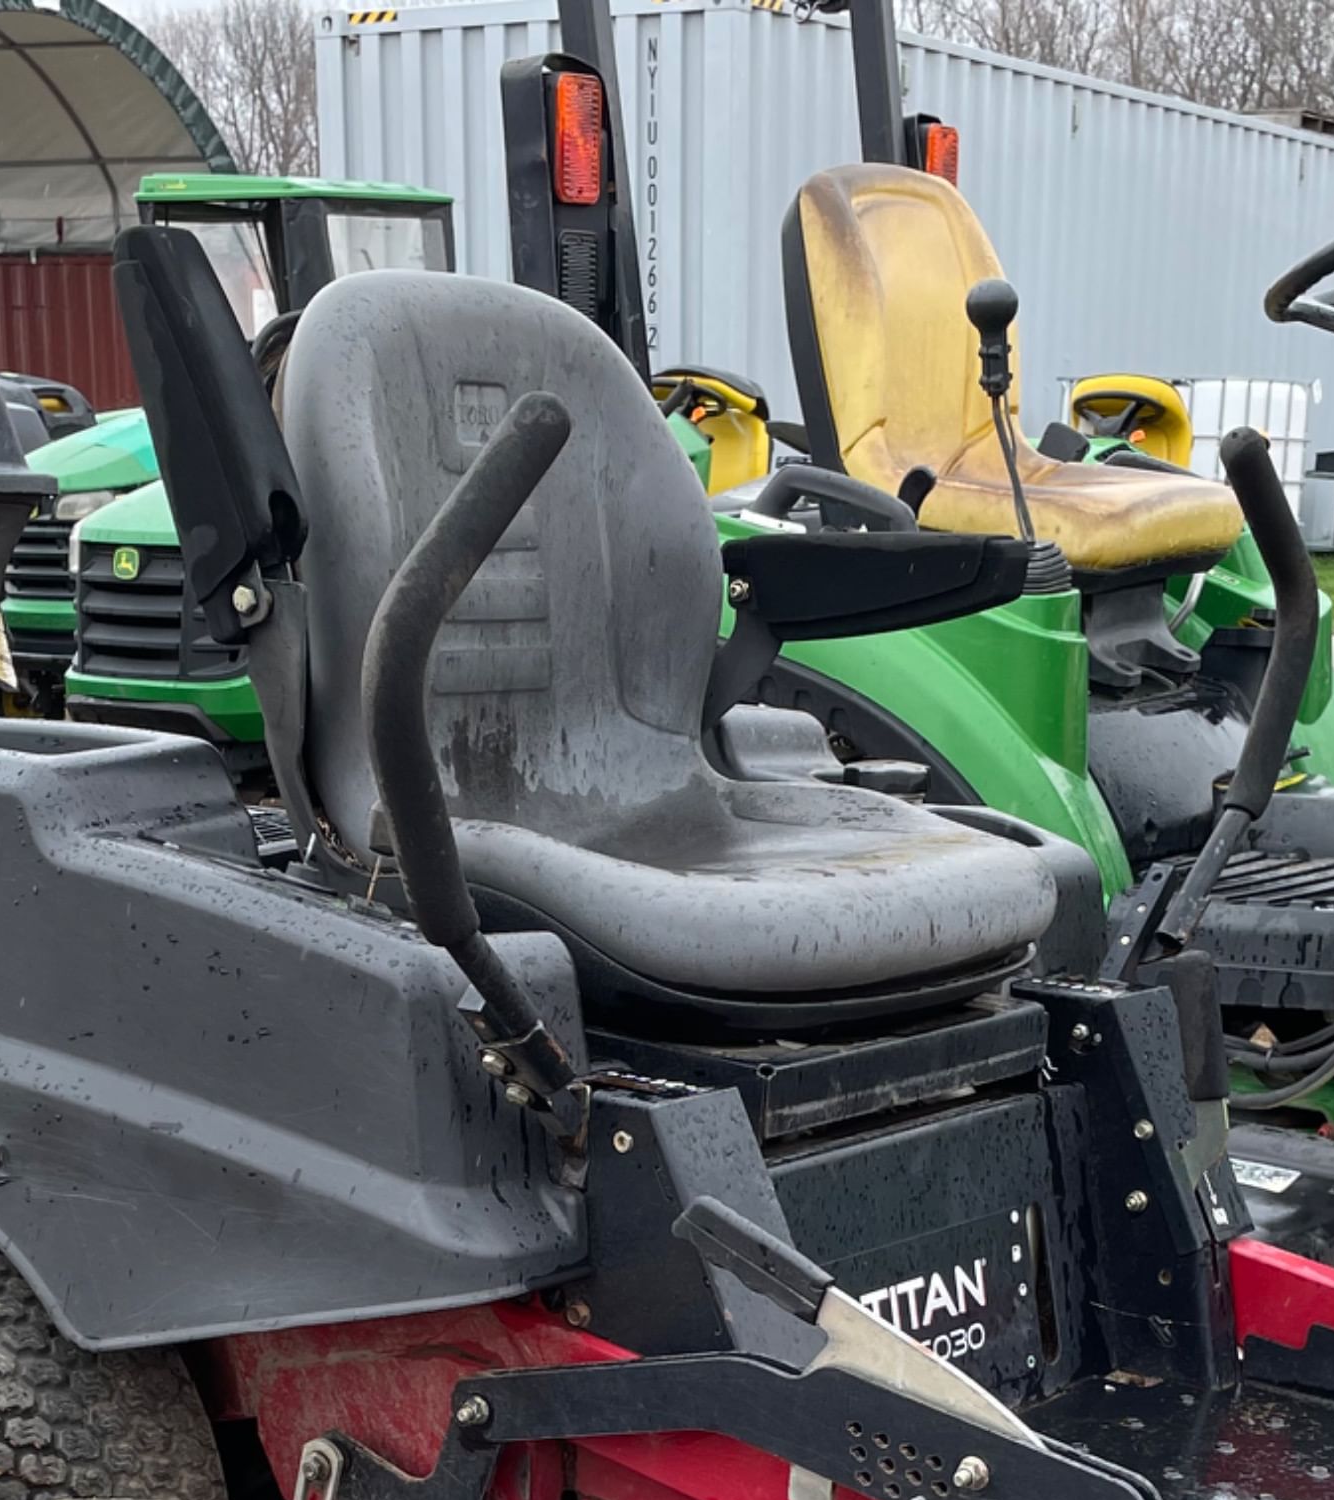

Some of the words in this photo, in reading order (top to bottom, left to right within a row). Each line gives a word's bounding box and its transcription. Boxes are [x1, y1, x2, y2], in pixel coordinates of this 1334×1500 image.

[648, 37, 659, 146] NYIU
[859, 1258, 987, 1330] TITAN
[921, 1322, 986, 1361] 030
